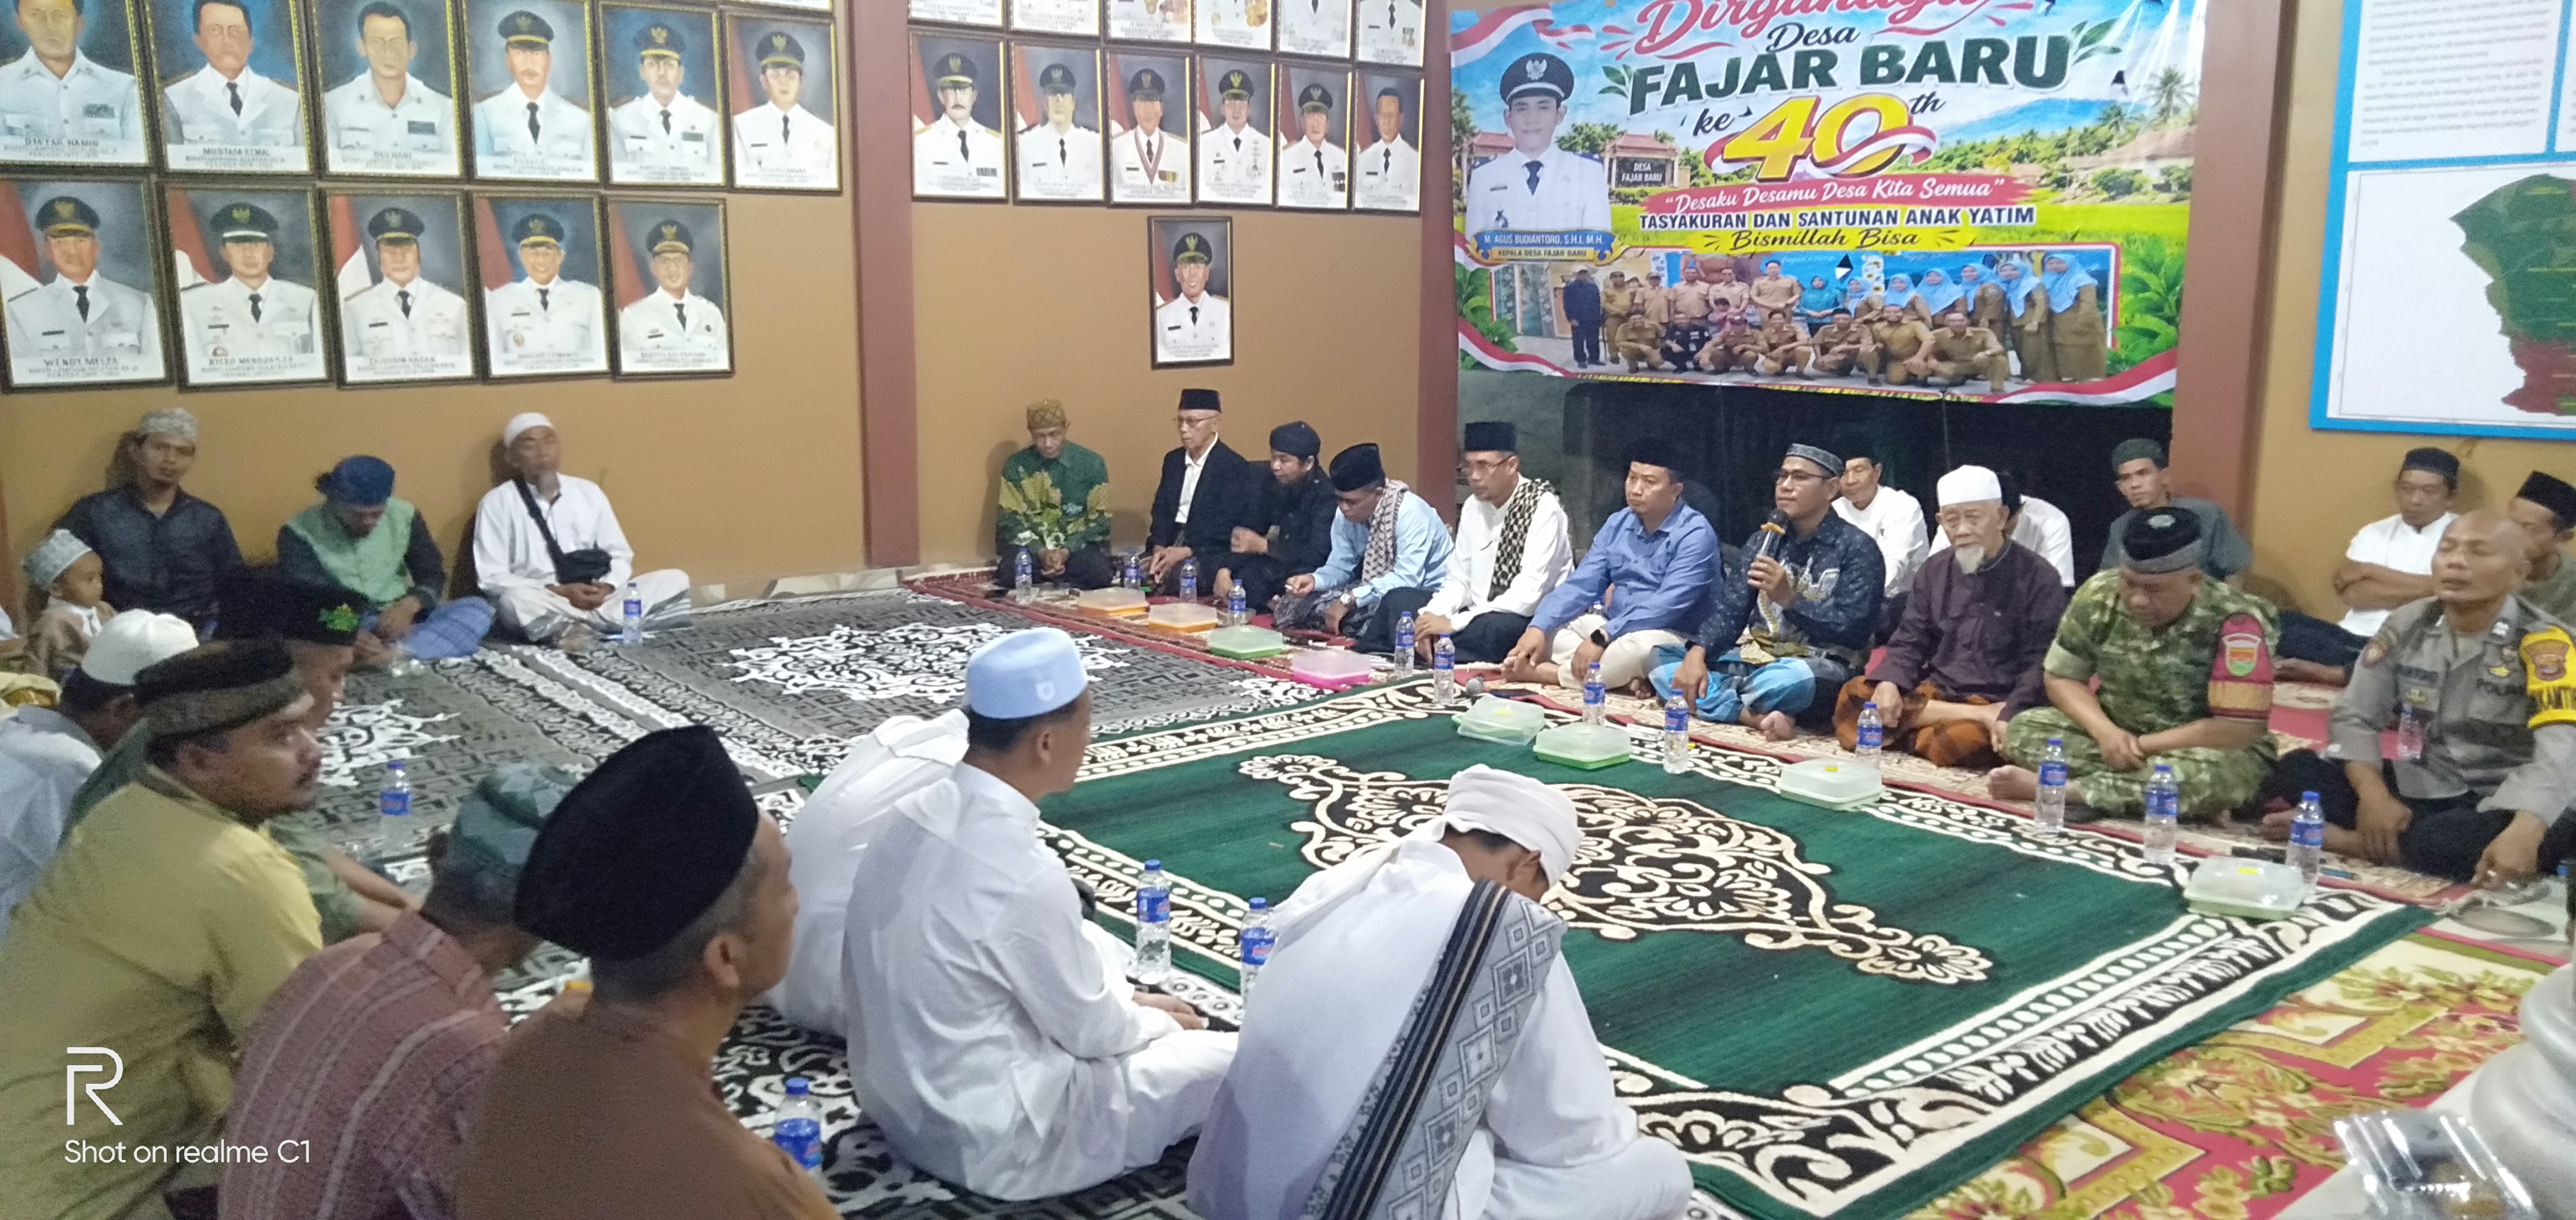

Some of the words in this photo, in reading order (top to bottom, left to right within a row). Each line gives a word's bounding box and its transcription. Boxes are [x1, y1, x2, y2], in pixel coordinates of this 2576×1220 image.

[1634, 0, 1985, 54] Dirgay
[1765, 22, 1860, 53] Desa
[1629, 48, 1838, 116] FAJAR
[1860, 35, 2070, 89] BARU
[1692, 108, 1735, 136] ke
[1622, 173, 1643, 183] FAJAR
[1644, 173, 1663, 182] BARU
[1634, 162, 1651, 172] DESA
[1743, 186, 1818, 206] Desamu
[1821, 181, 1868, 201] Desa
[1872, 179, 1915, 199] Kita
[1640, 214, 1746, 229] TASYAKURAN
[1754, 214, 1790, 227] DAN
[1798, 211, 1899, 227] SANTUNAN
[1905, 209, 1961, 225] ANAK
[1969, 207, 2035, 223] YATIM
[1495, 235, 1513, 244] AGUS
[1730, 229, 1849, 250] Bismillah
[1855, 227, 1921, 250] Bisa
